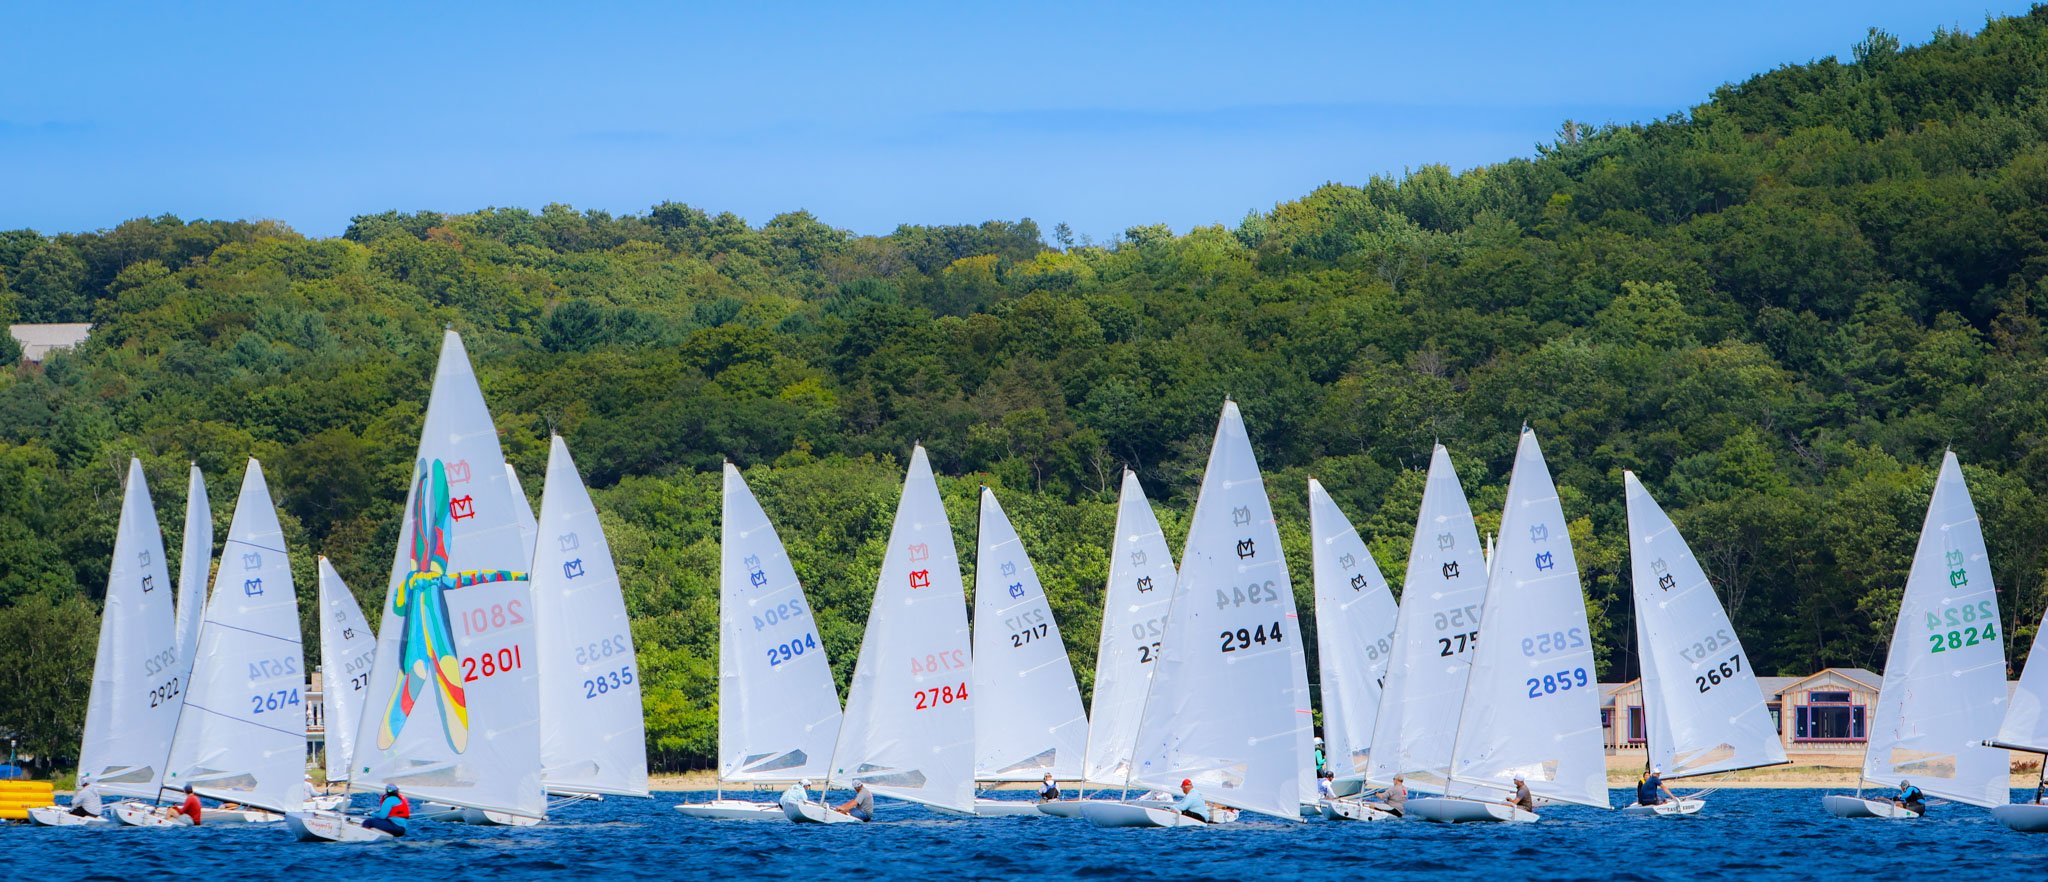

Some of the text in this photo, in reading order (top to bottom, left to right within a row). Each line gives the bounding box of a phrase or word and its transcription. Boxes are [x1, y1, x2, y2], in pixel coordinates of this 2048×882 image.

[768, 633, 816, 666] 2904
[1011, 624, 1048, 647] 2717
[1220, 622, 1282, 652] 2944
[1930, 623, 1996, 654] 2824
[462, 645, 521, 683] 2801
[1696, 654, 1741, 693] 2667
[149, 677, 179, 708] 2922
[584, 666, 633, 699] 2835
[914, 682, 968, 710] 2784
[1526, 668, 1588, 699] 2859
[252, 688, 300, 714] 2674
